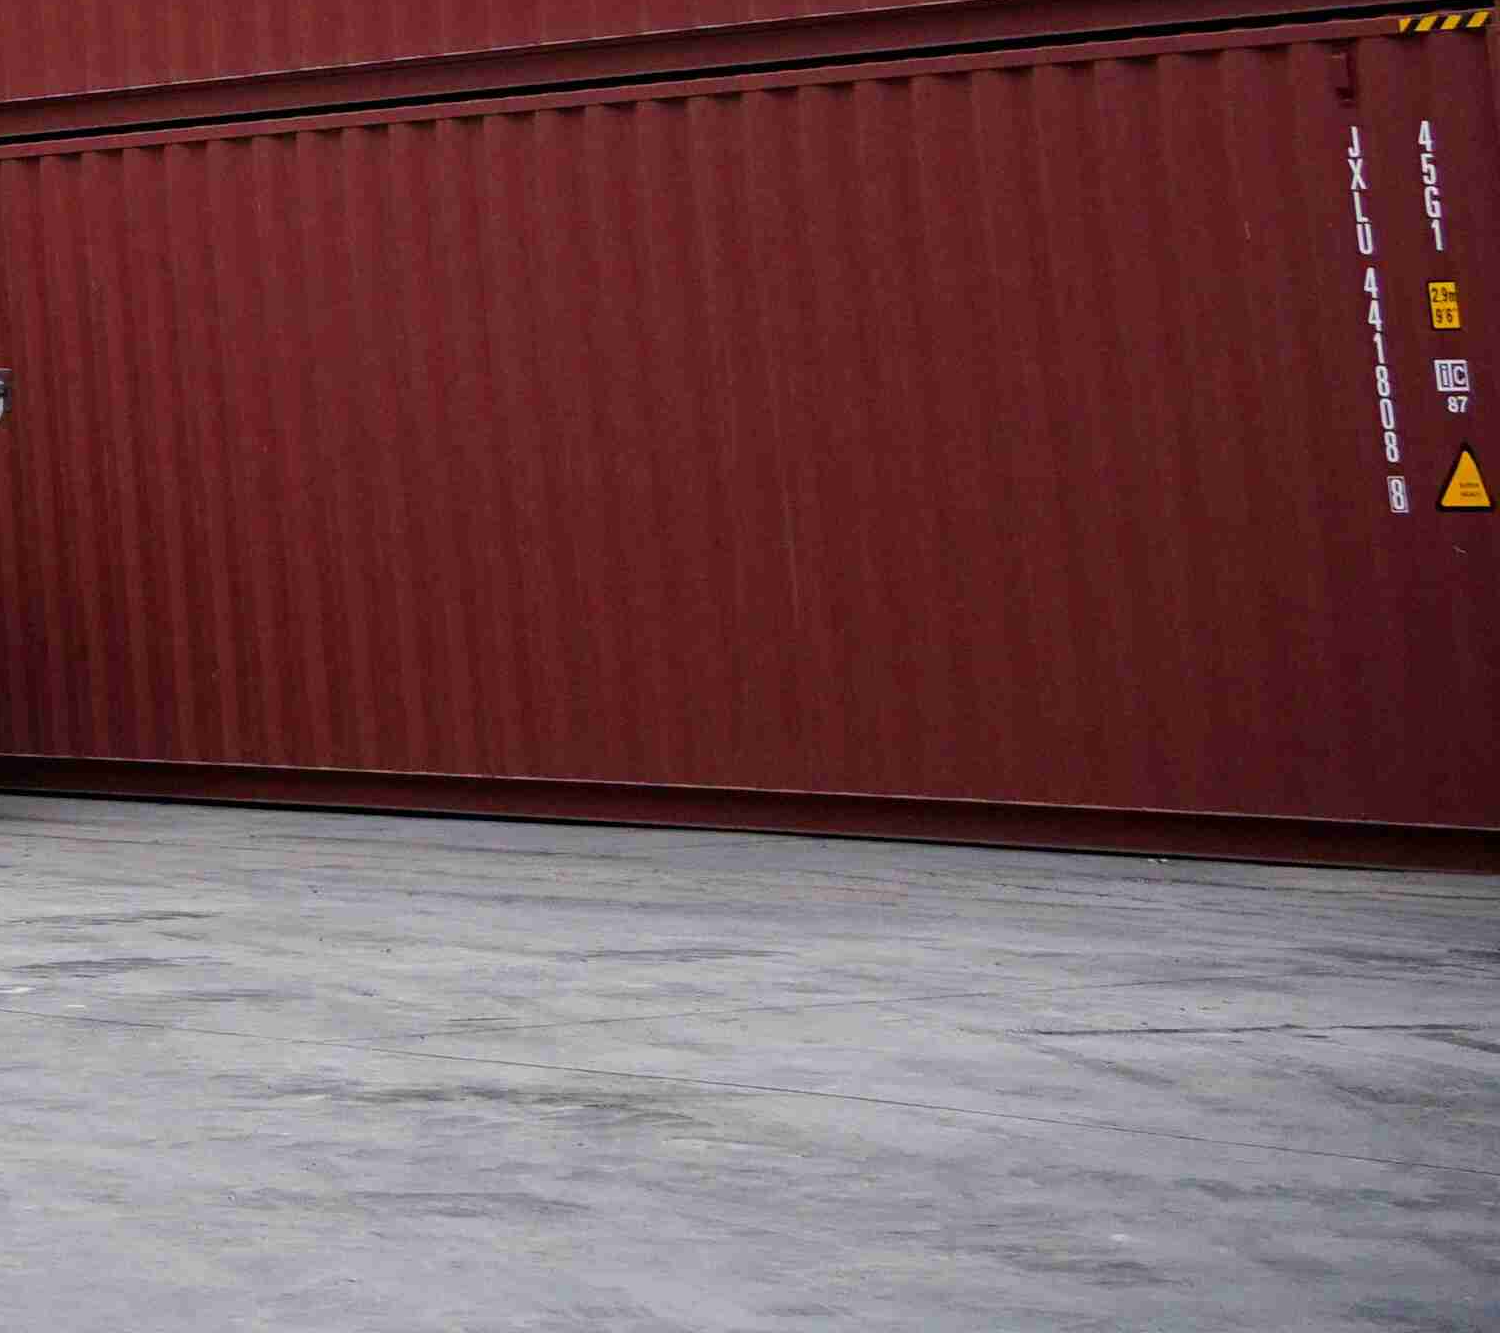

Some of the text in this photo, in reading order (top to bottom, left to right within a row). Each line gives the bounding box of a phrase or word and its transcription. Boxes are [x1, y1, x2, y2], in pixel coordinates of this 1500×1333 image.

[1417, 120, 1443, 251] 45G1
[1348, 126, 1406, 511] JXLU 441808 8
